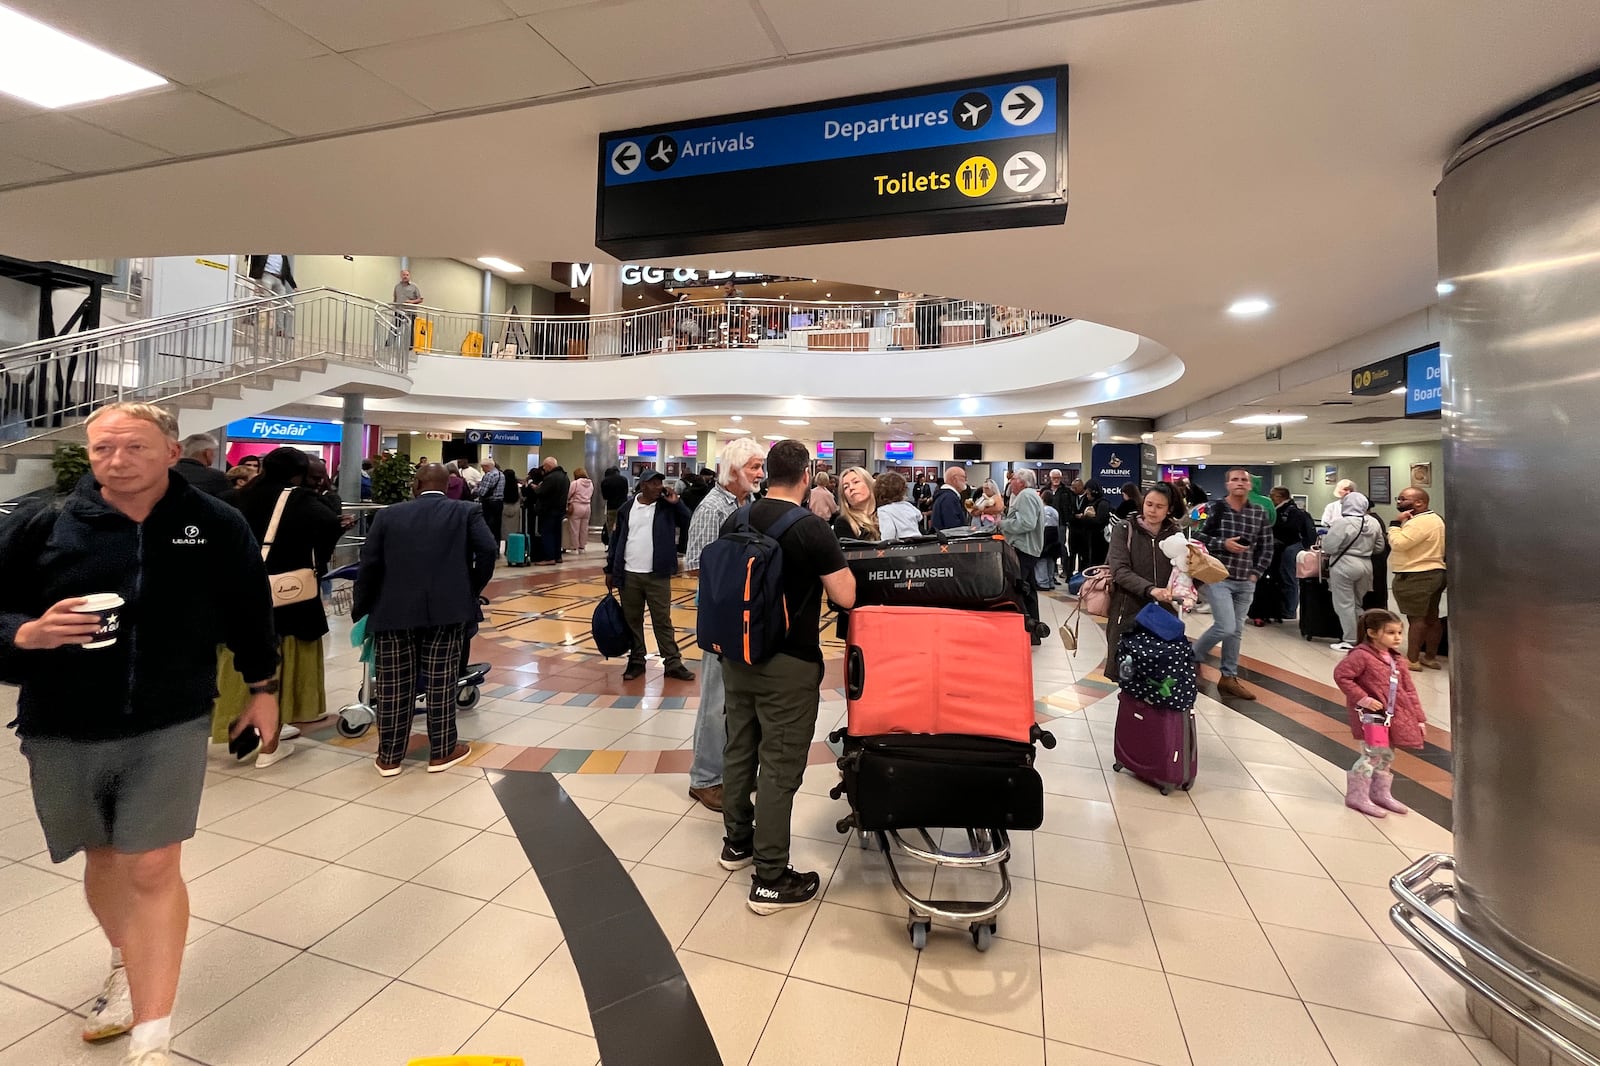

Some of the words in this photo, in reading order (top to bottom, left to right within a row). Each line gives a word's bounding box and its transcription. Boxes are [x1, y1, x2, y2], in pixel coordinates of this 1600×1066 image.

[823, 108, 949, 142] Departures
[680, 132, 755, 159] Arrivals
[873, 169, 951, 196] Toilets
[571, 263, 664, 289] MGG
[252, 421, 309, 438] FlySafair
[494, 433, 520, 441] Arrivals
[869, 570, 903, 581] HELLY
[905, 568, 953, 580] HANSEN
[756, 887, 779, 899] HOKA
